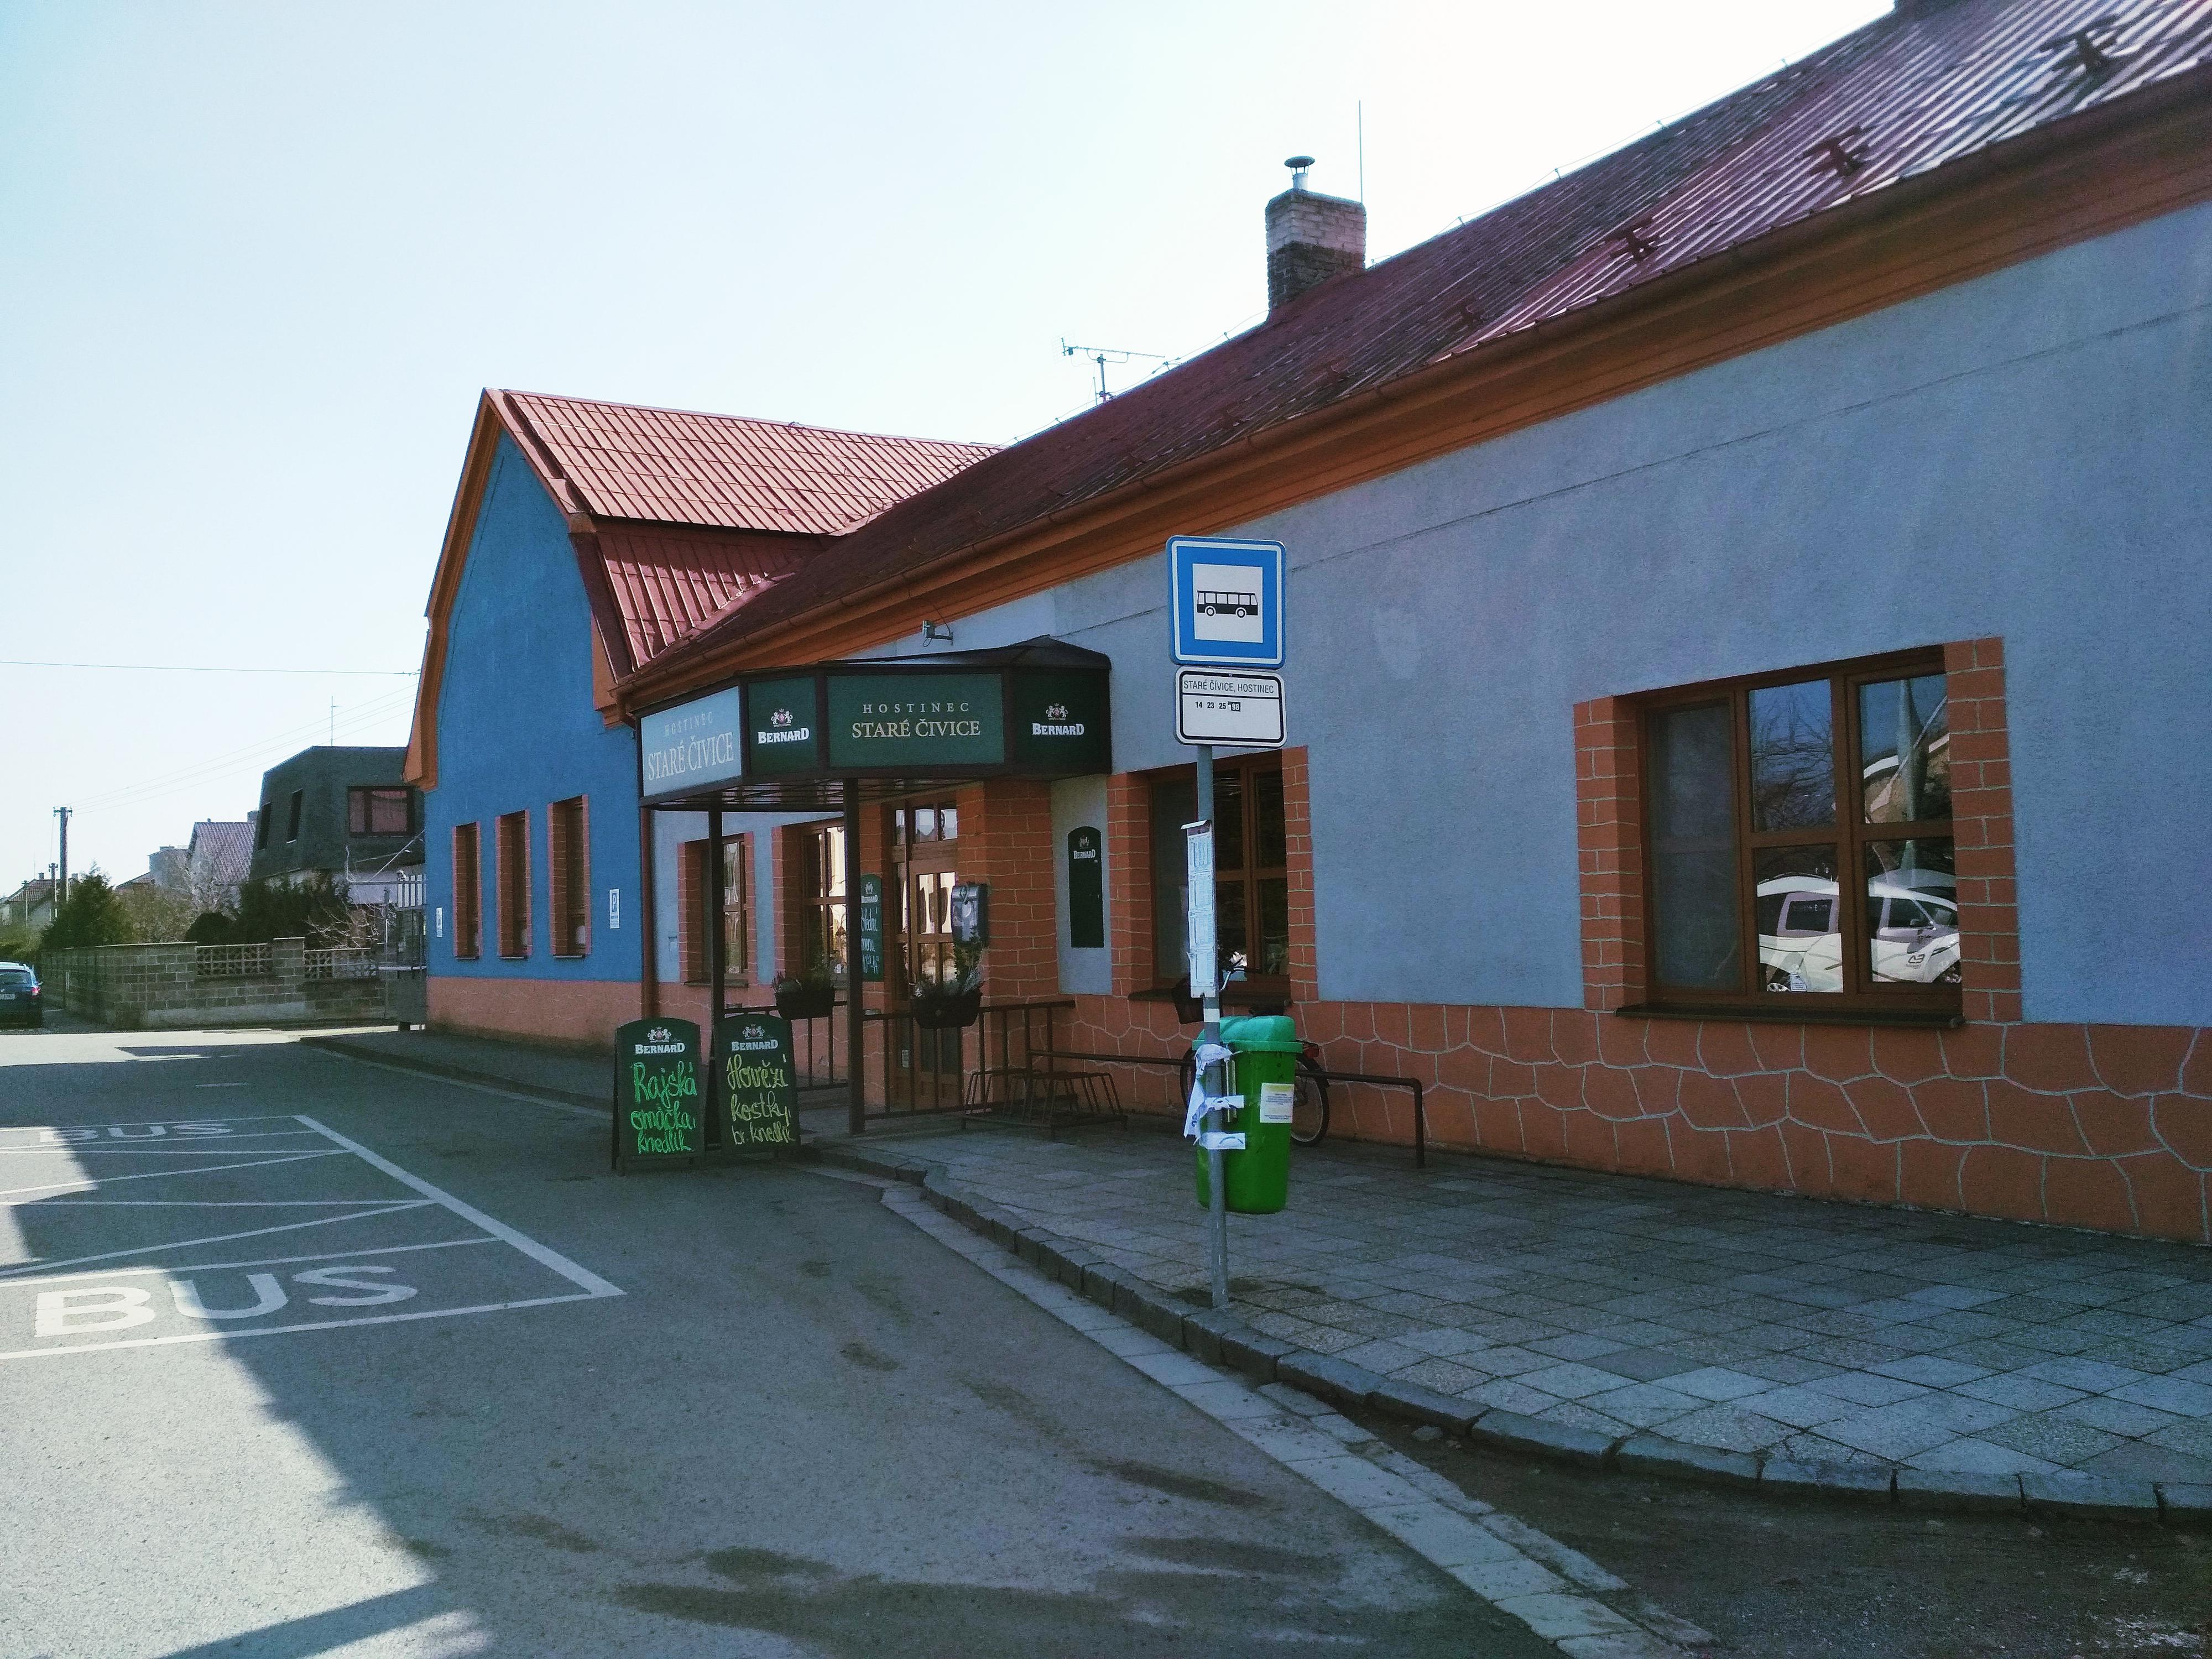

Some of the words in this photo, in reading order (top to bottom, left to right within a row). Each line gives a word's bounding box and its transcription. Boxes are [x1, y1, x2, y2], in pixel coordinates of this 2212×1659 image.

[1183, 679, 1208, 690] STARÉ
[1209, 680, 1236, 693] ČÍVICE,
[1238, 684, 1274, 693] HOSTINEC
[863, 702, 969, 713] HOSTINEC
[1232, 702, 1240, 711] 98
[665, 711, 713, 737] HOSTINEC
[852, 719, 911, 738] STARÉ
[915, 719, 981, 737] ČIVICE
[1032, 723, 1084, 735] BERNARD
[758, 727, 810, 744] BERNARD
[648, 739, 686, 781] STARÉ
[688, 732, 734, 770] ČIVICE
[1073, 849, 1095, 859] BERNARD
[635, 1042, 685, 1055] BERNARD
[732, 1039, 779, 1051] BERNARD
[726, 1054, 789, 1090] Hovězí
[633, 1061, 697, 1108] Rajská
[40, 1123, 233, 1142] BUS
[34, 1266, 419, 1337] BUS
